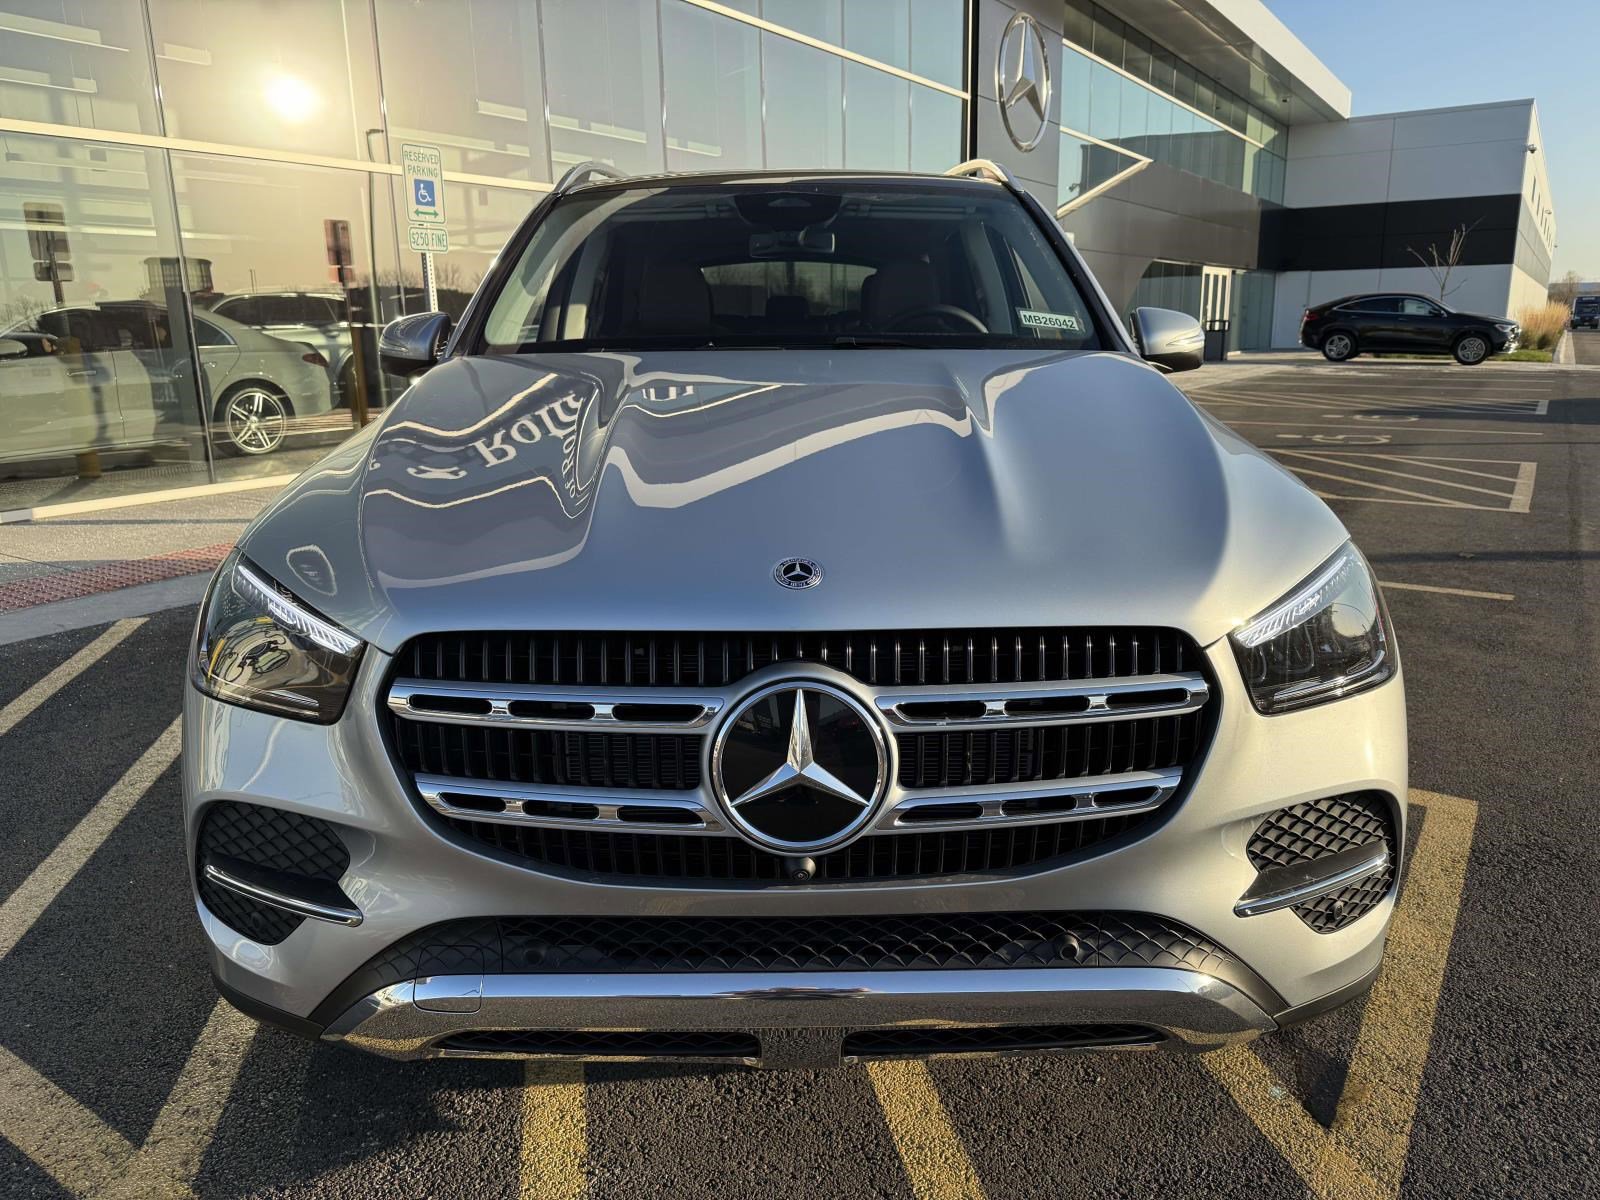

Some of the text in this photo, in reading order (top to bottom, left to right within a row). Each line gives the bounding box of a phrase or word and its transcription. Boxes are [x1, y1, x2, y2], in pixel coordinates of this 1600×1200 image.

[403, 150, 439, 165] RESERVED
[407, 164, 438, 178] PARKING
[411, 231, 447, 248] $250 FINE
[1023, 314, 1076, 329] MB26042
